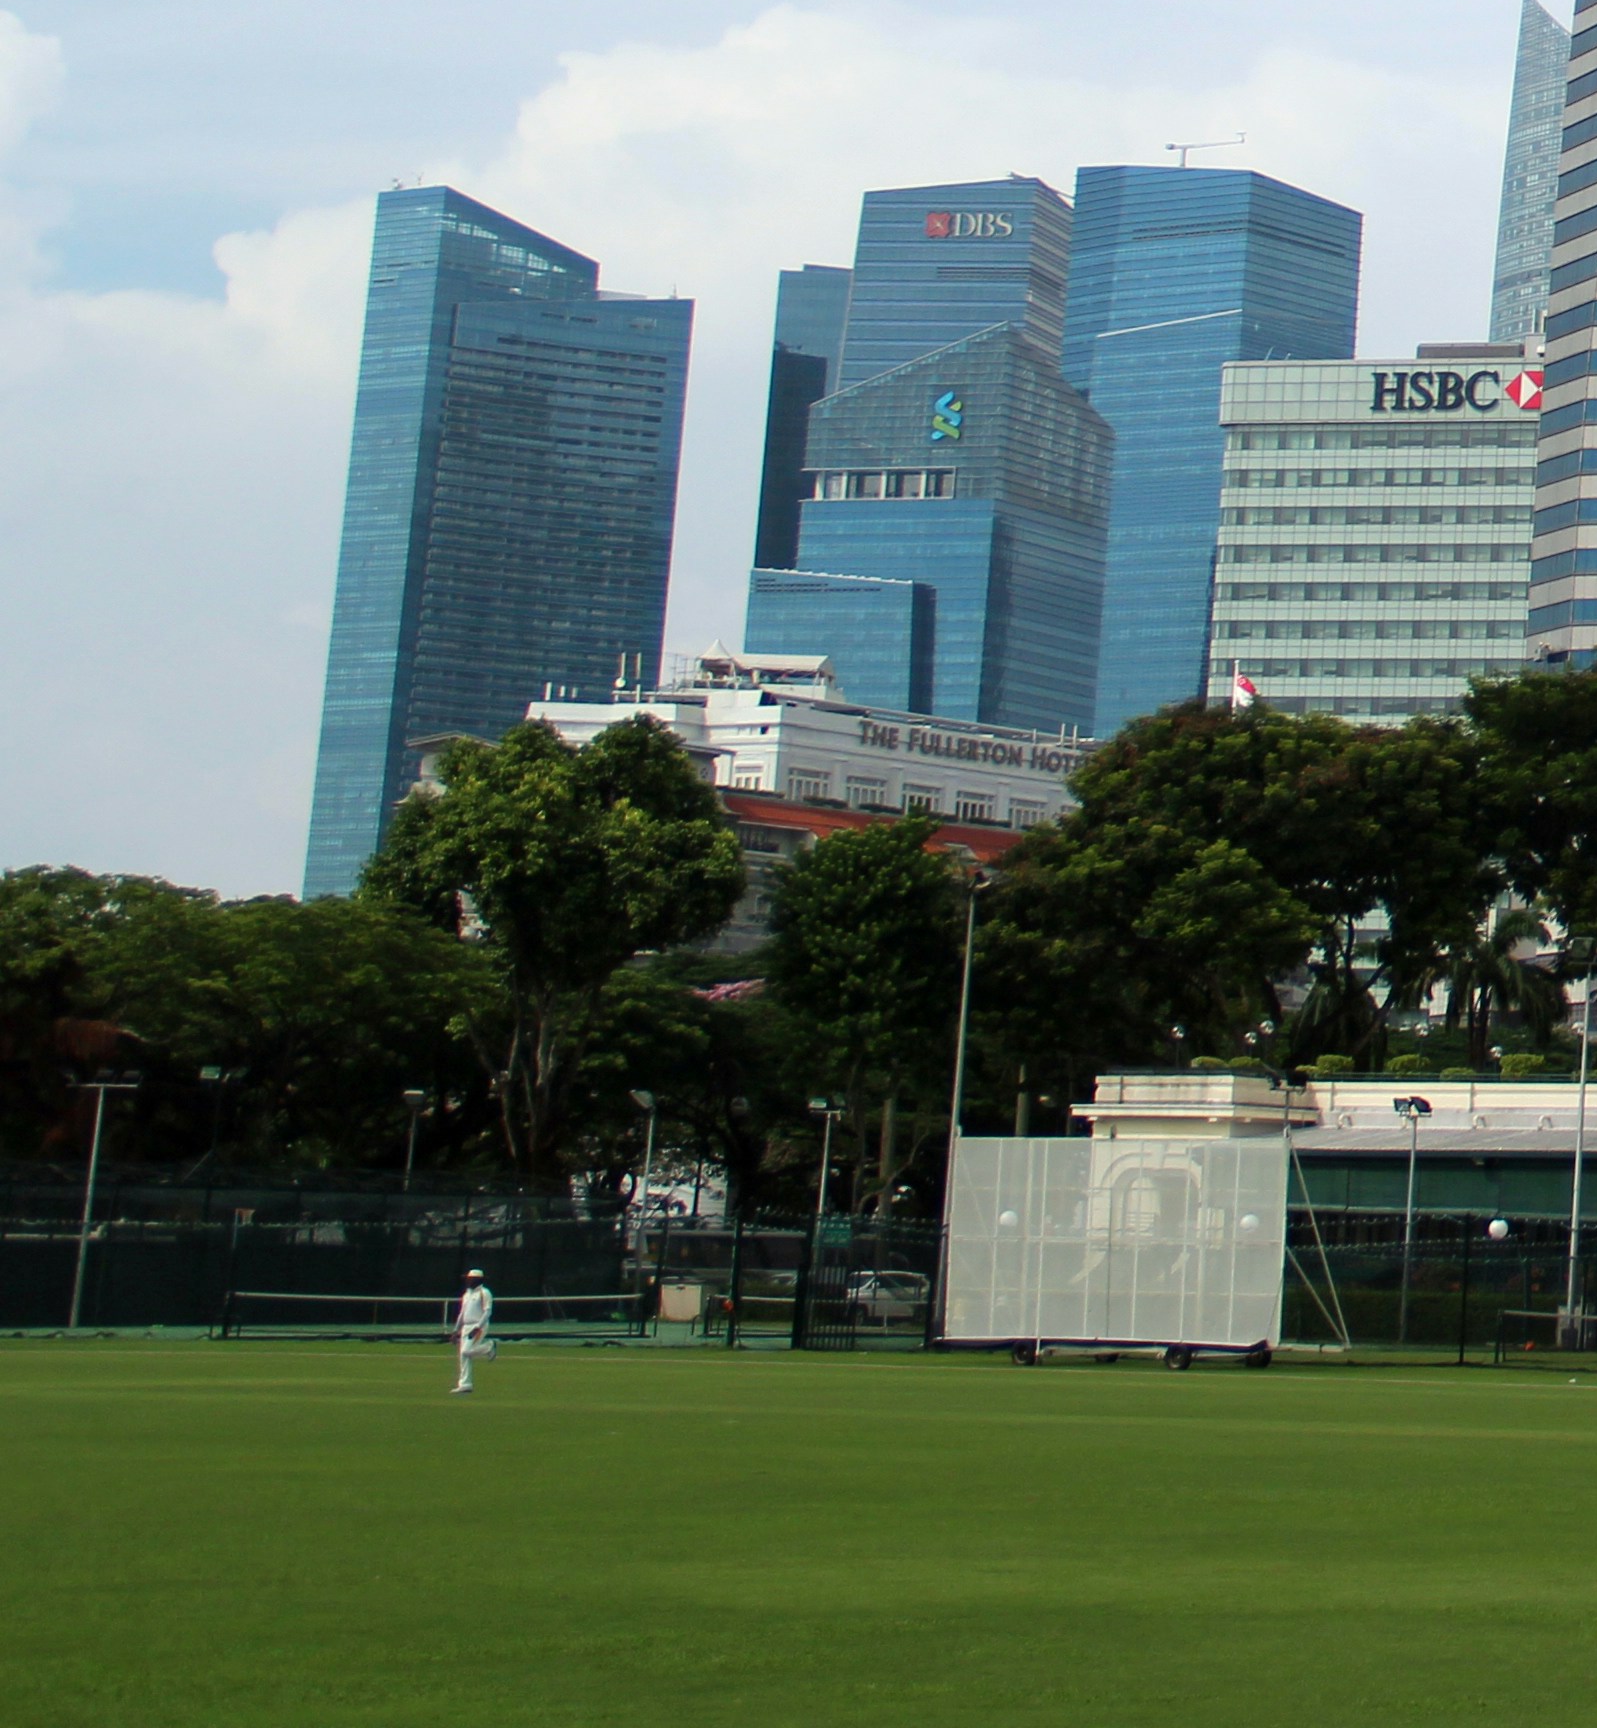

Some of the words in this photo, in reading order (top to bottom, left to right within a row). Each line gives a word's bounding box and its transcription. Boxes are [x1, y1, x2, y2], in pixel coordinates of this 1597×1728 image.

[951, 212, 1014, 238] DBS
[1370, 370, 1499, 411] HSBC
[859, 720, 900, 750] THE
[908, 727, 1024, 768] FULLERTON
